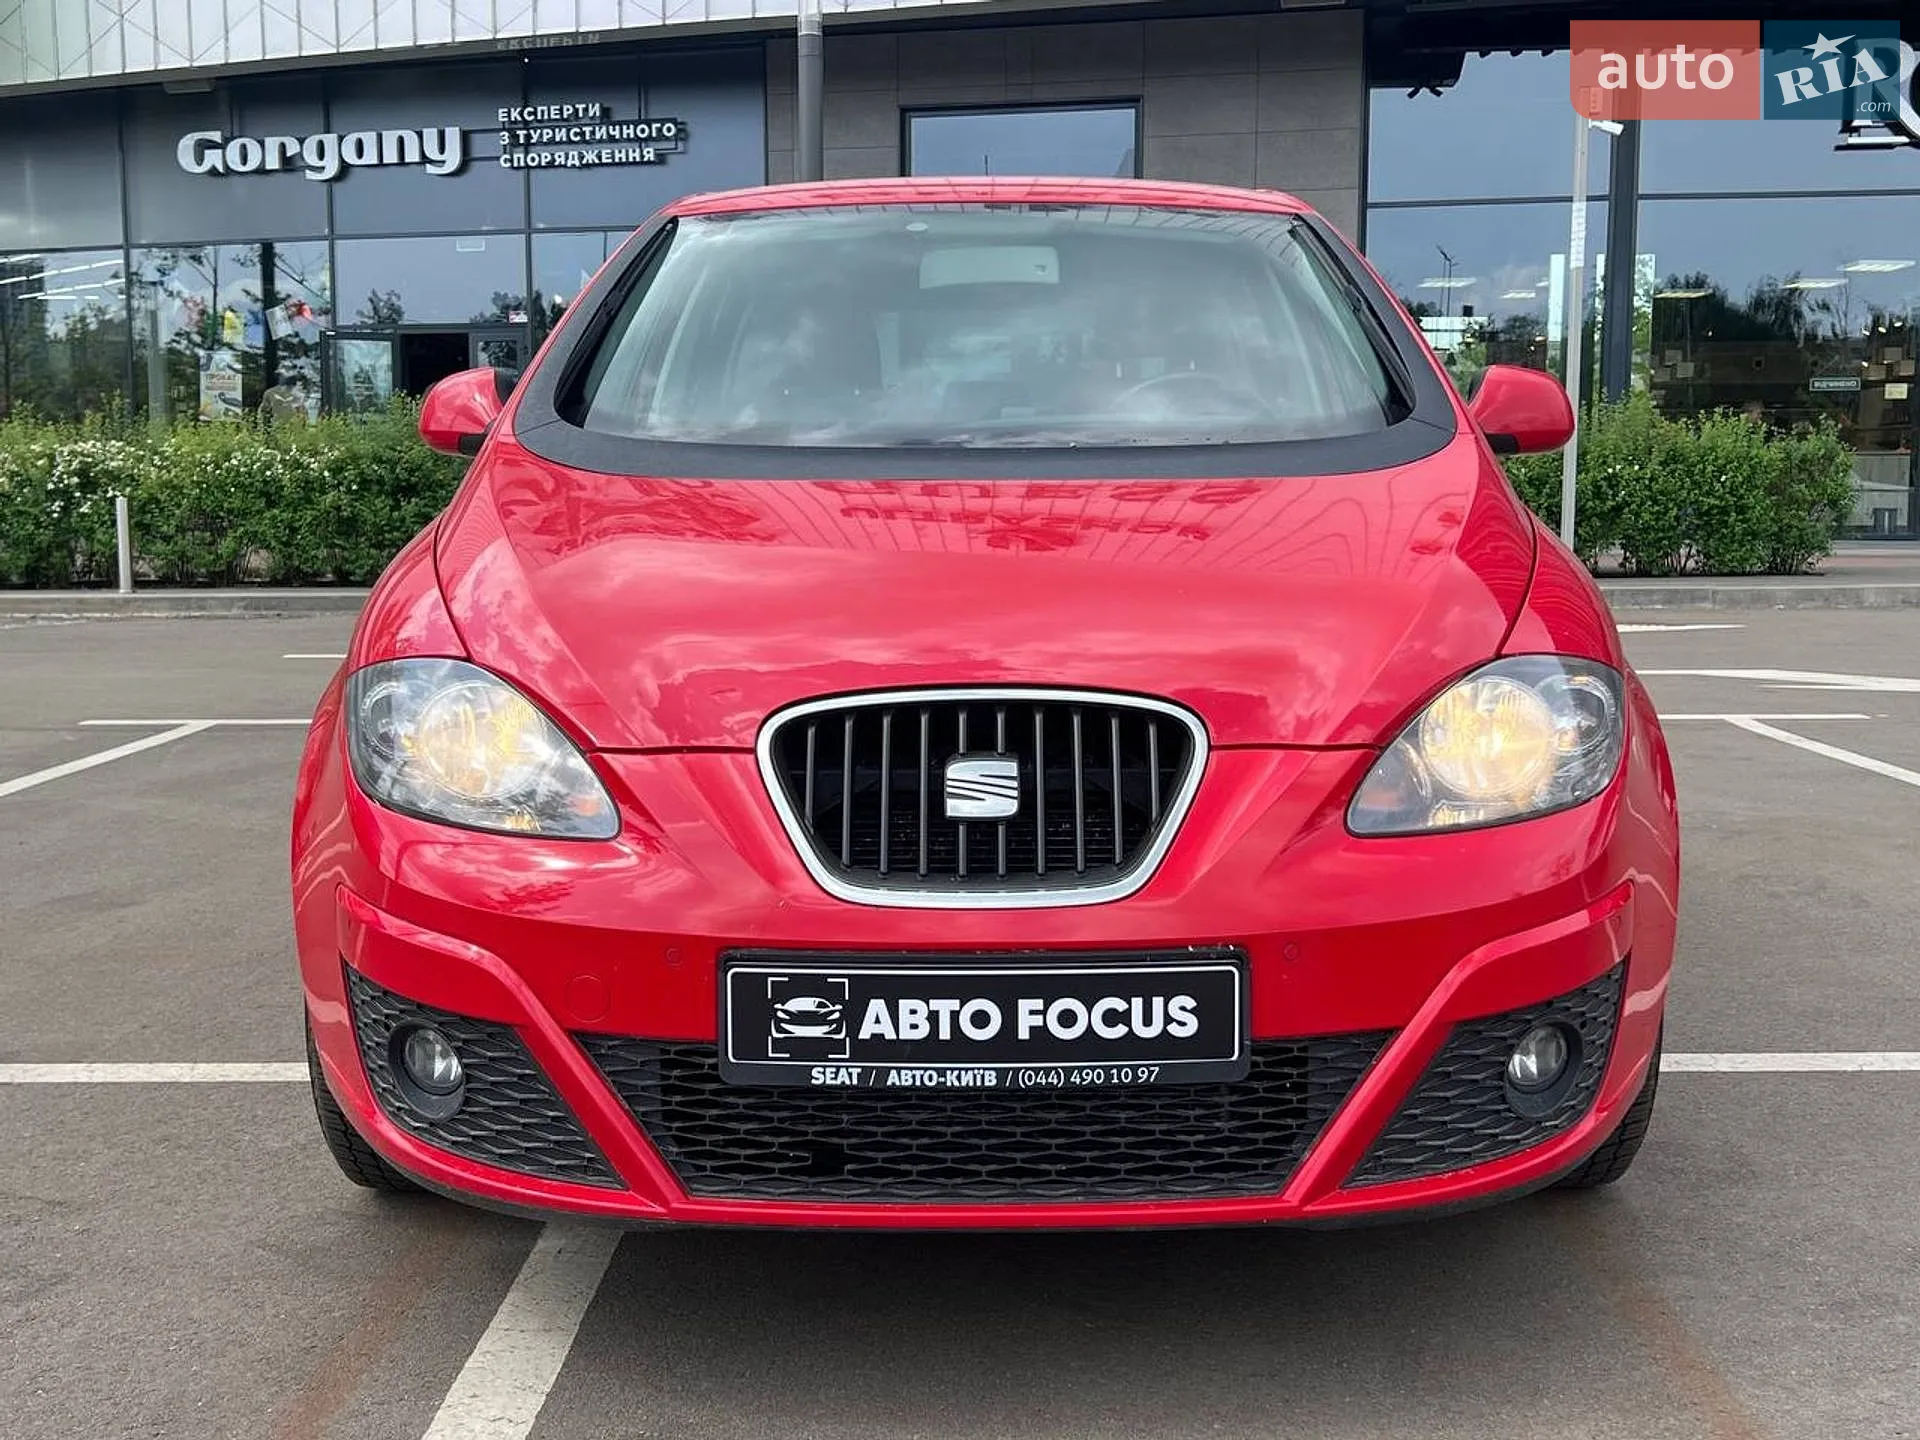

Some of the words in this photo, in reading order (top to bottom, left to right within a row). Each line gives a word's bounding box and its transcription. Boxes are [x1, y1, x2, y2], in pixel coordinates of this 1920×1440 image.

[498, 103, 600, 121] ЕКСПЕРТИ
[516, 122, 676, 144] ТУРИСТИЧНОГО
[176, 126, 463, 181] Gorgany
[500, 147, 656, 168] СПОРЯДЖЕННЯ
[858, 998, 1002, 1041] АВТО
[1017, 995, 1199, 1040] FOCUS
[811, 1067, 862, 1085] SEAT
[1018, 1068, 1065, 1088] (044)
[1070, 1068, 1105, 1085] 490
[1110, 1067, 1133, 1083] 10
[1137, 1066, 1160, 1083] 97
